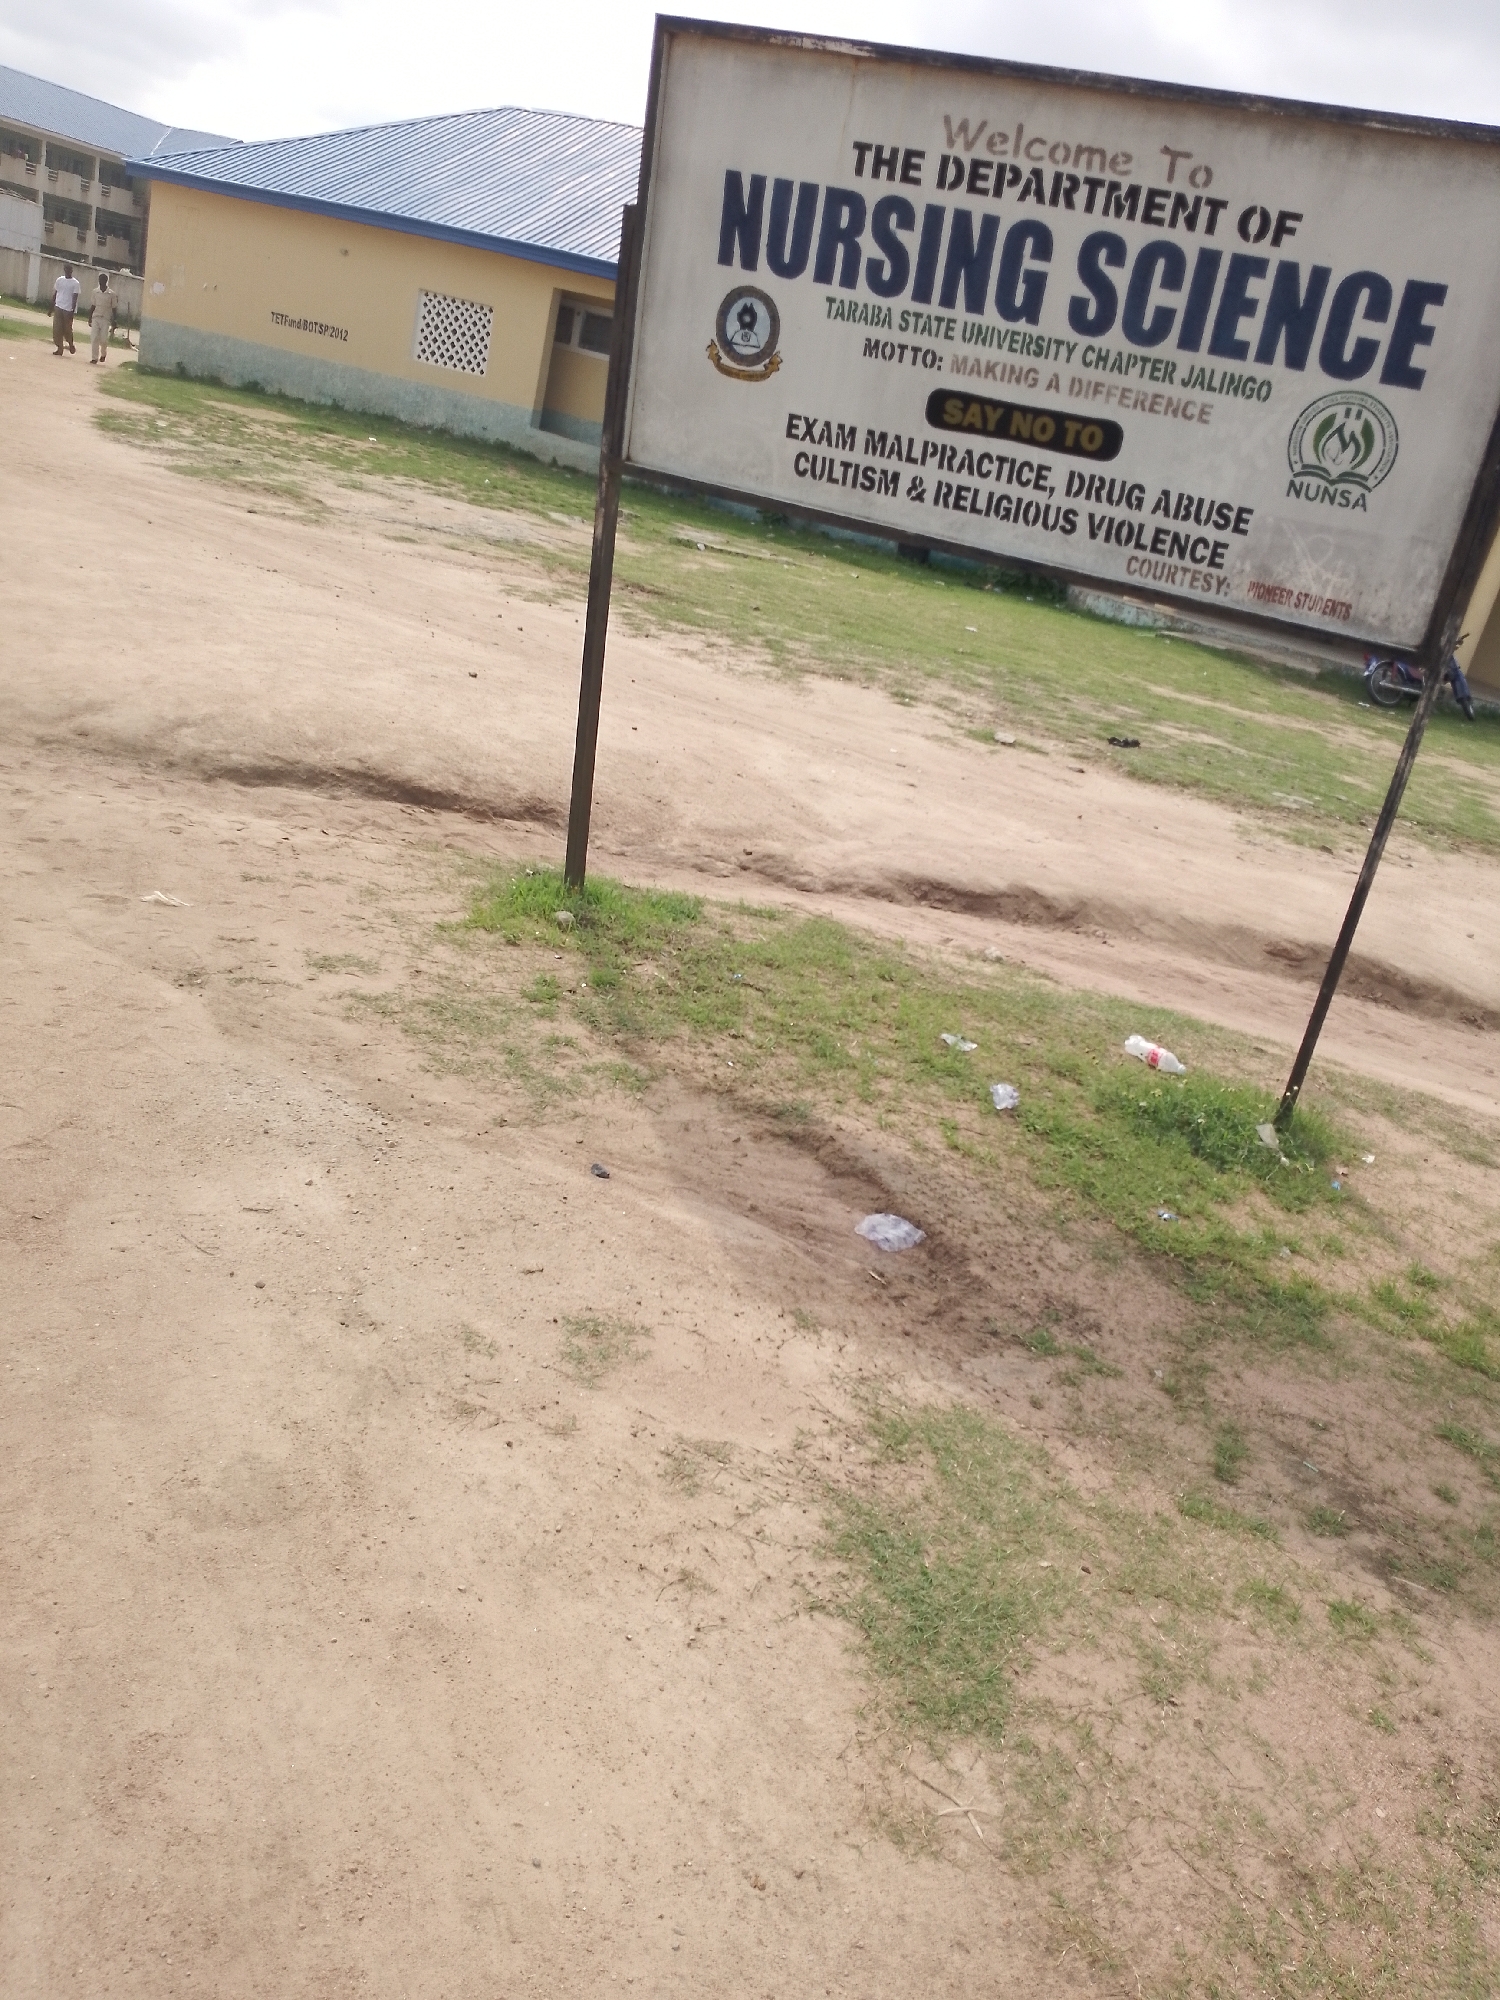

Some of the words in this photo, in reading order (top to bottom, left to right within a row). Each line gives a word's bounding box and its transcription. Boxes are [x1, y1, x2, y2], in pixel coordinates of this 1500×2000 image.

[852, 141, 926, 187] THE
[936, 154, 1229, 236] DEPARTMENT
[1237, 205, 1304, 248] OF
[943, 114, 1133, 177] Welcome
[1160, 144, 1214, 190] To
[717, 169, 1054, 327] NURSING
[1068, 230, 1449, 391] SCIENCE
[825, 296, 894, 331] TARABA
[898, 309, 956, 341] STATE
[961, 321, 1079, 365] UNIVERSITY
[1081, 343, 1178, 386] CHAPTER
[1180, 364, 1274, 403] JALINGO
[862, 337, 944, 372] MOTTO:
[948, 353, 1039, 389] MAKING
[1045, 373, 1062, 394] A
[1067, 377, 1215, 426] DIFFERENCE
[943, 398, 1005, 432] SAY
[1009, 411, 1057, 444] NO
[1064, 417, 1104, 452] TO
[785, 413, 858, 452] EXAM
[864, 428, 1056, 499] MALPRACTICE,
[1065, 469, 1146, 512] DRUG
[1150, 489, 1254, 537] ABUSE
[793, 451, 901, 498] CULTISM
[906, 475, 927, 504] &
[933, 480, 1079, 536] RELIGIOUS
[1087, 512, 1230, 570] VIOLENCE
[1285, 479, 1368, 513] NUNSA
[1126, 555, 1231, 597] COURTESY:
[1247, 580, 1294, 609] PIONEER
[1293, 591, 1354, 622] STUDENTS
